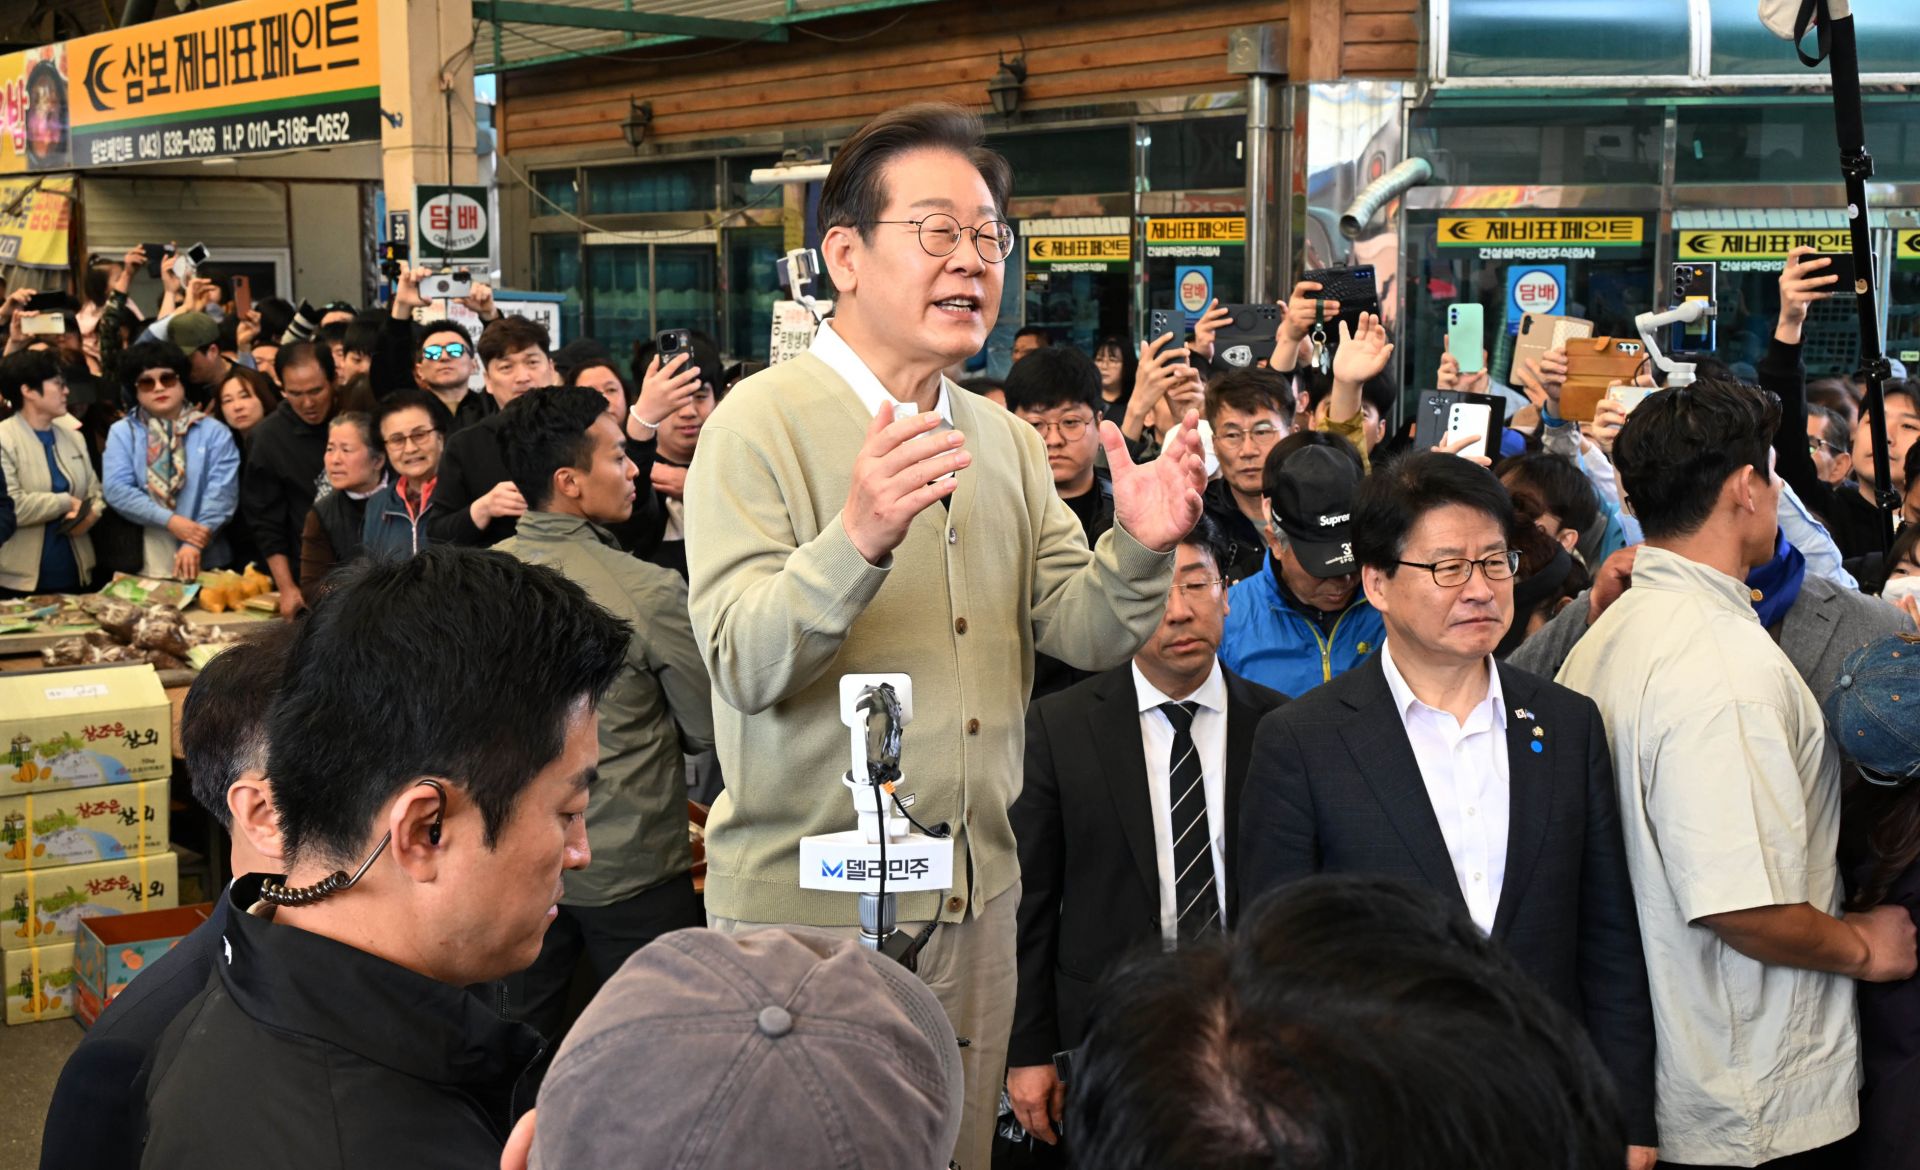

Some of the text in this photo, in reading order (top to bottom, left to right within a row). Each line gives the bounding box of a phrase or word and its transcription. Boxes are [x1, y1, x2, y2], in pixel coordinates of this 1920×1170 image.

[138, 130, 161, 159] 043)
[247, 111, 350, 149] 010-5186-0652
[1151, 221, 1245, 240] 제비표페인트
[1487, 220, 1633, 240] 제비표페인트
[1051, 240, 1129, 256] 제비표페인트
[1519, 284, 1555, 301] 담배
[846, 858, 929, 881] 델리민주
